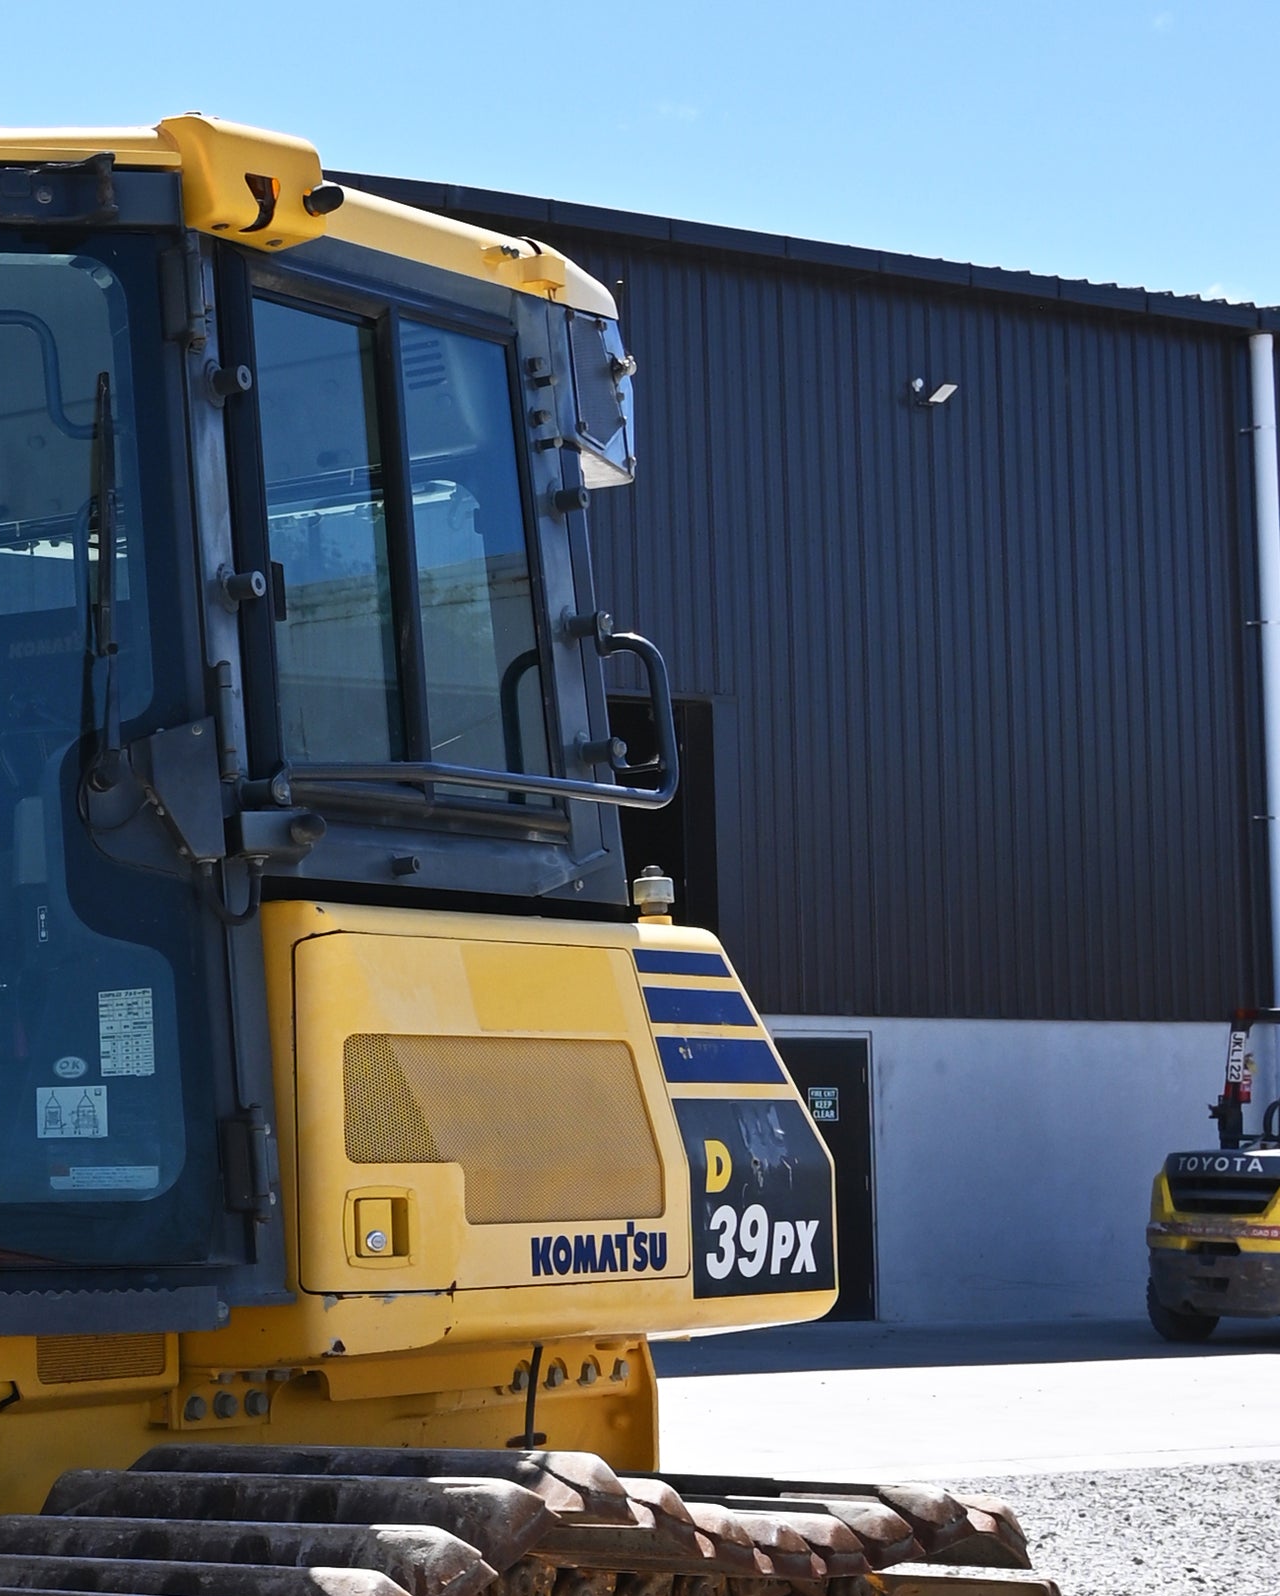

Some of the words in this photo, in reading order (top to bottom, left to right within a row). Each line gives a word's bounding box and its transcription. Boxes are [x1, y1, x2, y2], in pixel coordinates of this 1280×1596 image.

[1229, 1033, 1244, 1081] JKL122
[704, 1140, 733, 1193] D
[1178, 1157, 1264, 1173] TOYOTA
[531, 1221, 667, 1276] KOMATSU
[706, 1204, 820, 1280] 39PX
